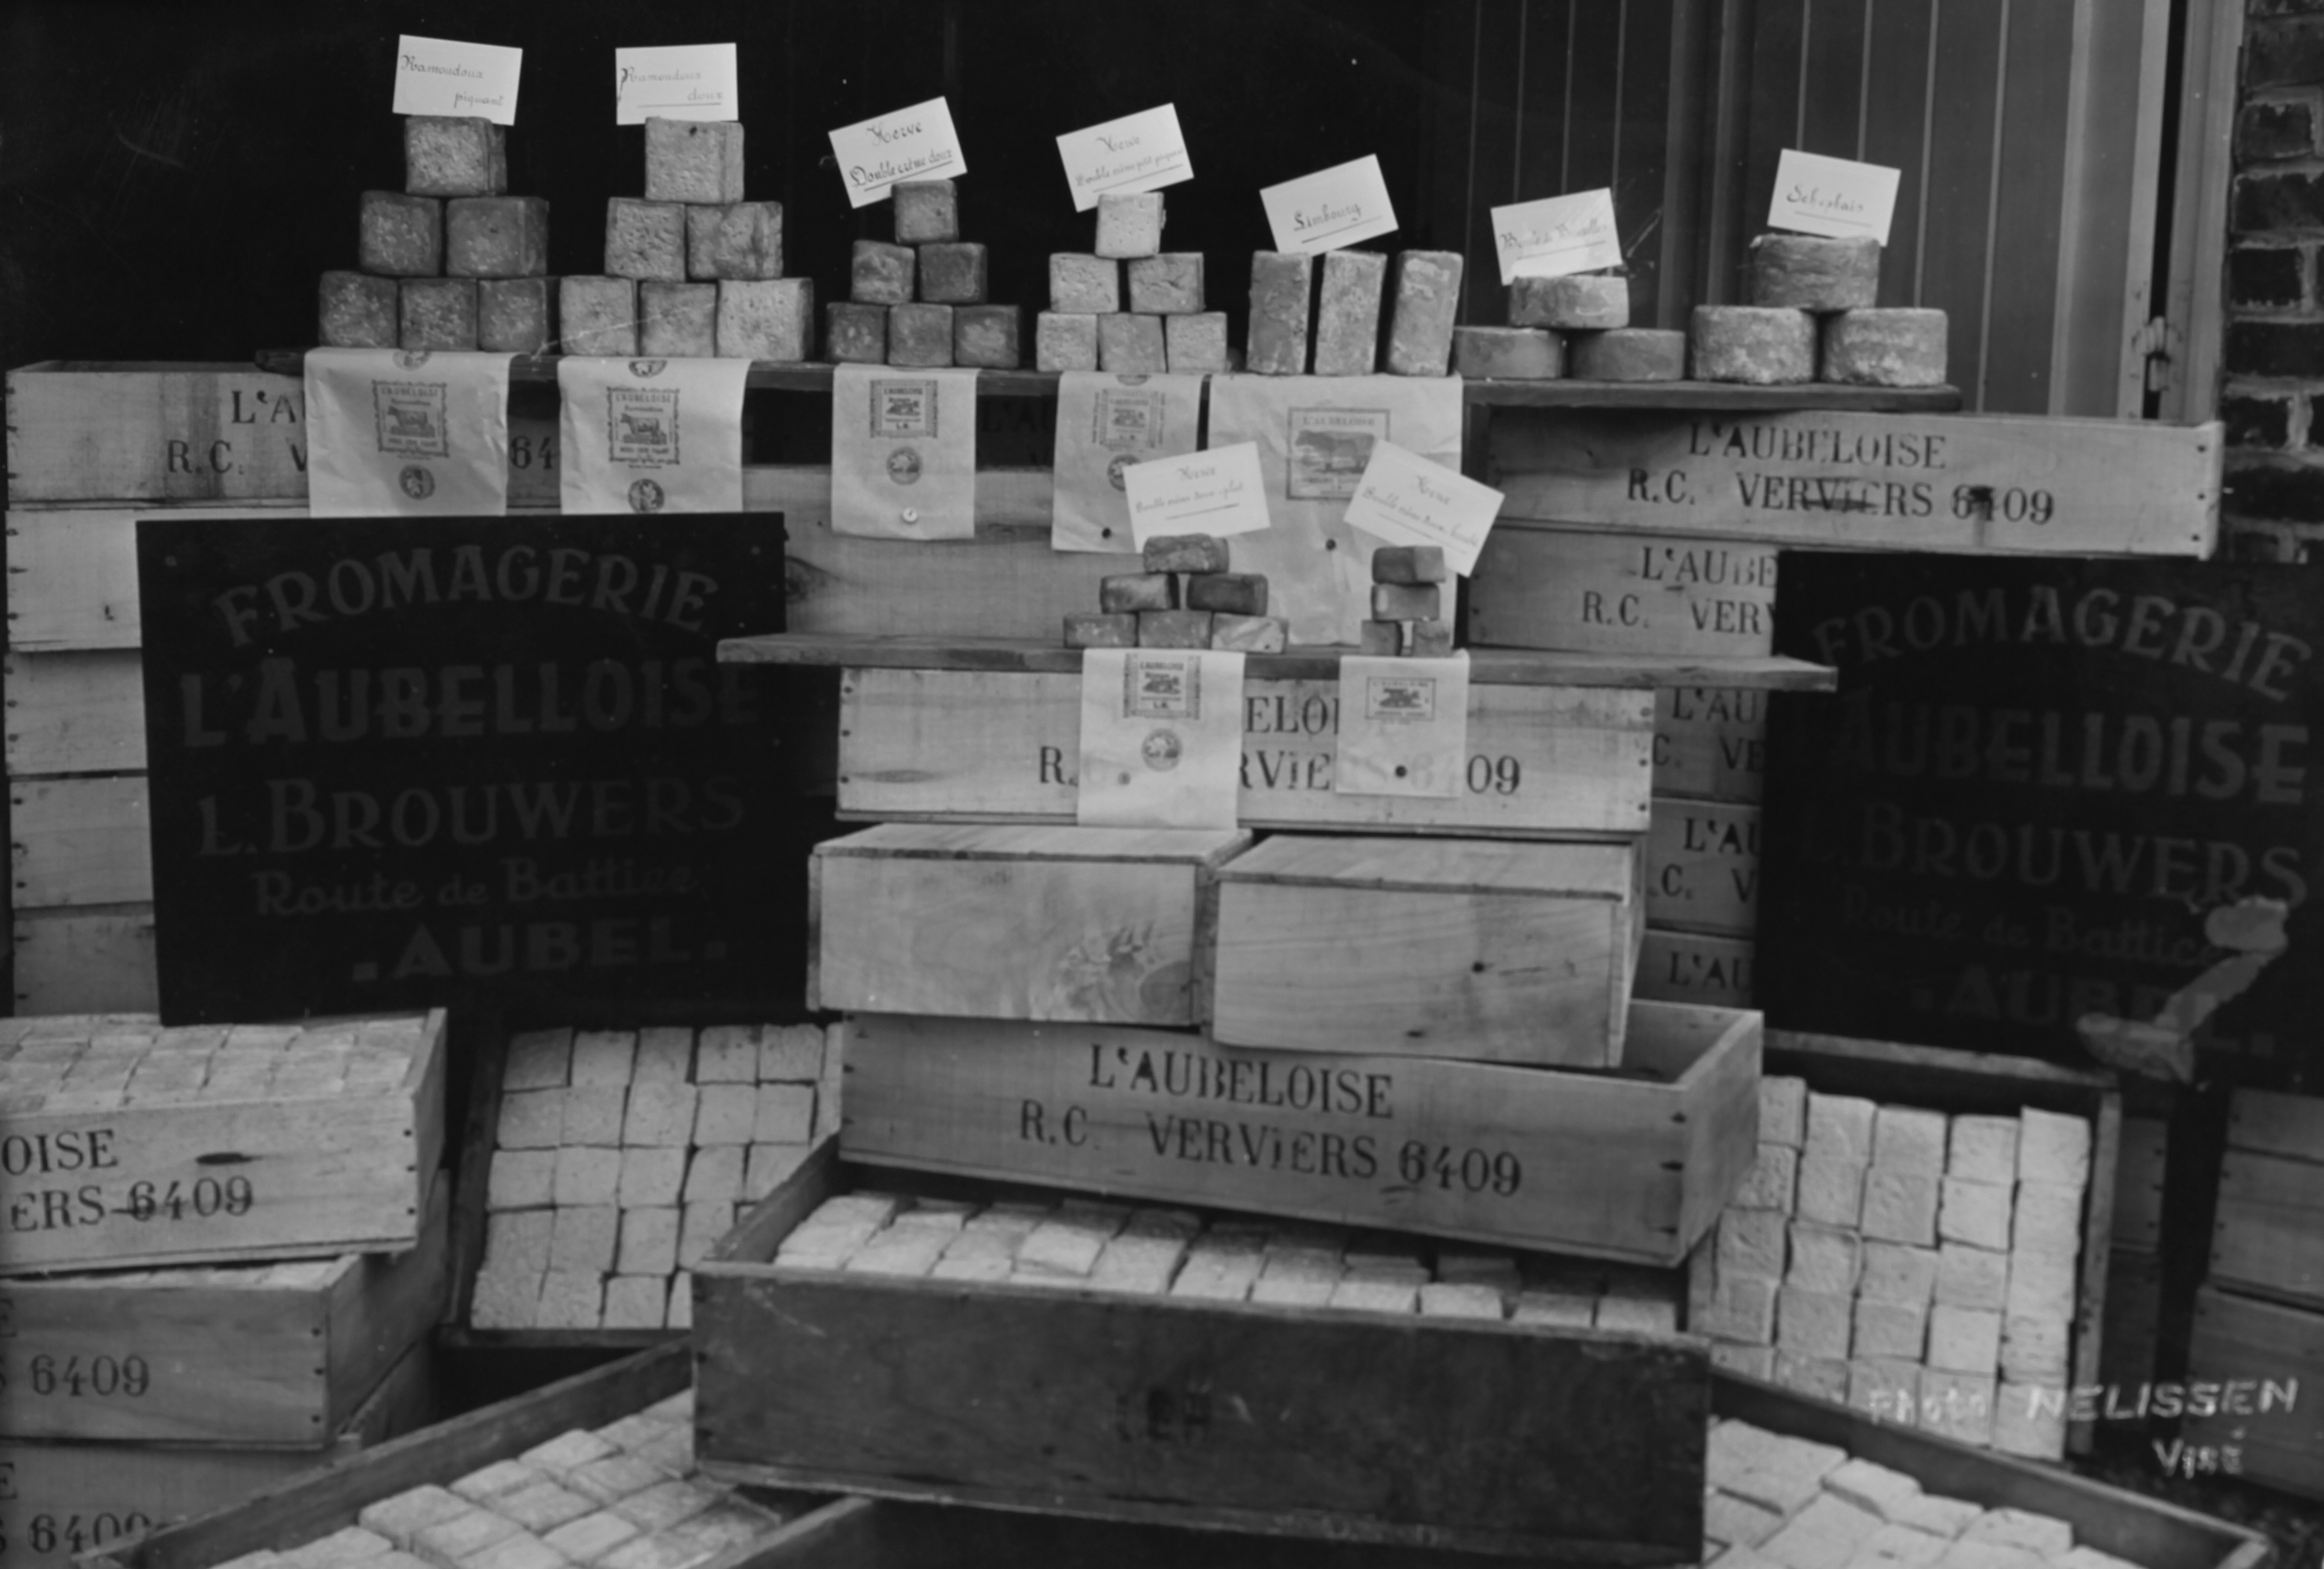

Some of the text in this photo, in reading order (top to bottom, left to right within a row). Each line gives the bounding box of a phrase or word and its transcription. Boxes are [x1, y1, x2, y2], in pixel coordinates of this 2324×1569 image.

[453, 92, 505, 108] piquant
[687, 89, 724, 102] doux
[849, 161, 895, 187] Double
[231, 390, 306, 424] L'A
[168, 439, 244, 475] R.C.
[1689, 423, 1947, 470] L'AUBELOISE
[1627, 467, 1696, 506] R.C.
[1735, 472, 1934, 518] VERVIERS
[211, 544, 719, 648] FROMAGERIE
[1582, 589, 1776, 635] R.C. VER
[1811, 584, 2312, 702] FROMAGERIE
[179, 656, 759, 748] L'AUBELLOISE
[193, 776, 746, 858] L. BROUWERS
[1861, 802, 2308, 914] BROUWERS
[250, 856, 701, 916] Route de Battice
[1842, 883, 1962, 941] Route
[1982, 911, 2029, 950] de
[1089, 1043, 1394, 1120] L'AUBELOISE
[1, 1129, 119, 1175] OISE
[1145, 1112, 1378, 1180] VERVIERS
[1398, 1139, 1522, 1198] 6409
[128, 1175, 254, 1222] 6409
[29, 1353, 150, 1398] 6409
